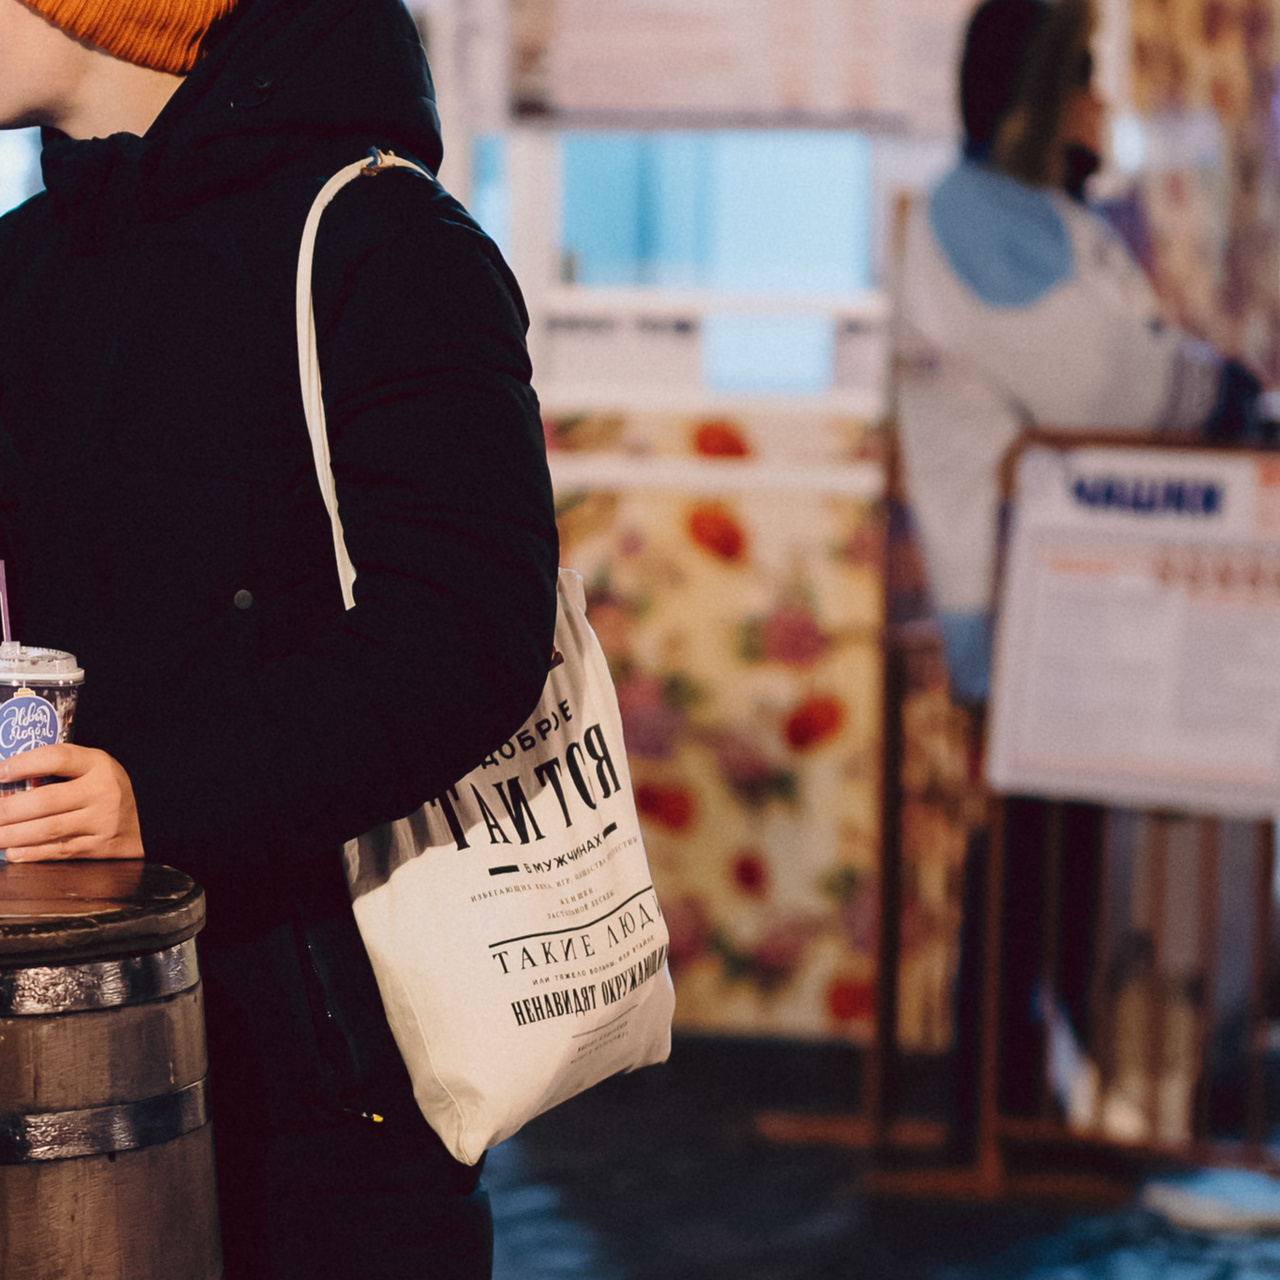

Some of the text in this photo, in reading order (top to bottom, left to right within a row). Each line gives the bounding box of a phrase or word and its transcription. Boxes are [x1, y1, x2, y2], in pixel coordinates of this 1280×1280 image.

[430, 722, 622, 851] ТАИТСЯ
[532, 833, 603, 874] МУЖЧИНАХ
[492, 933, 596, 975] ТАКИЕ
[532, 976, 550, 986] ИЛИ
[555, 970, 587, 982] ТЯЖЕЛО
[510, 984, 597, 1027] НЕНАВИДЯТ
